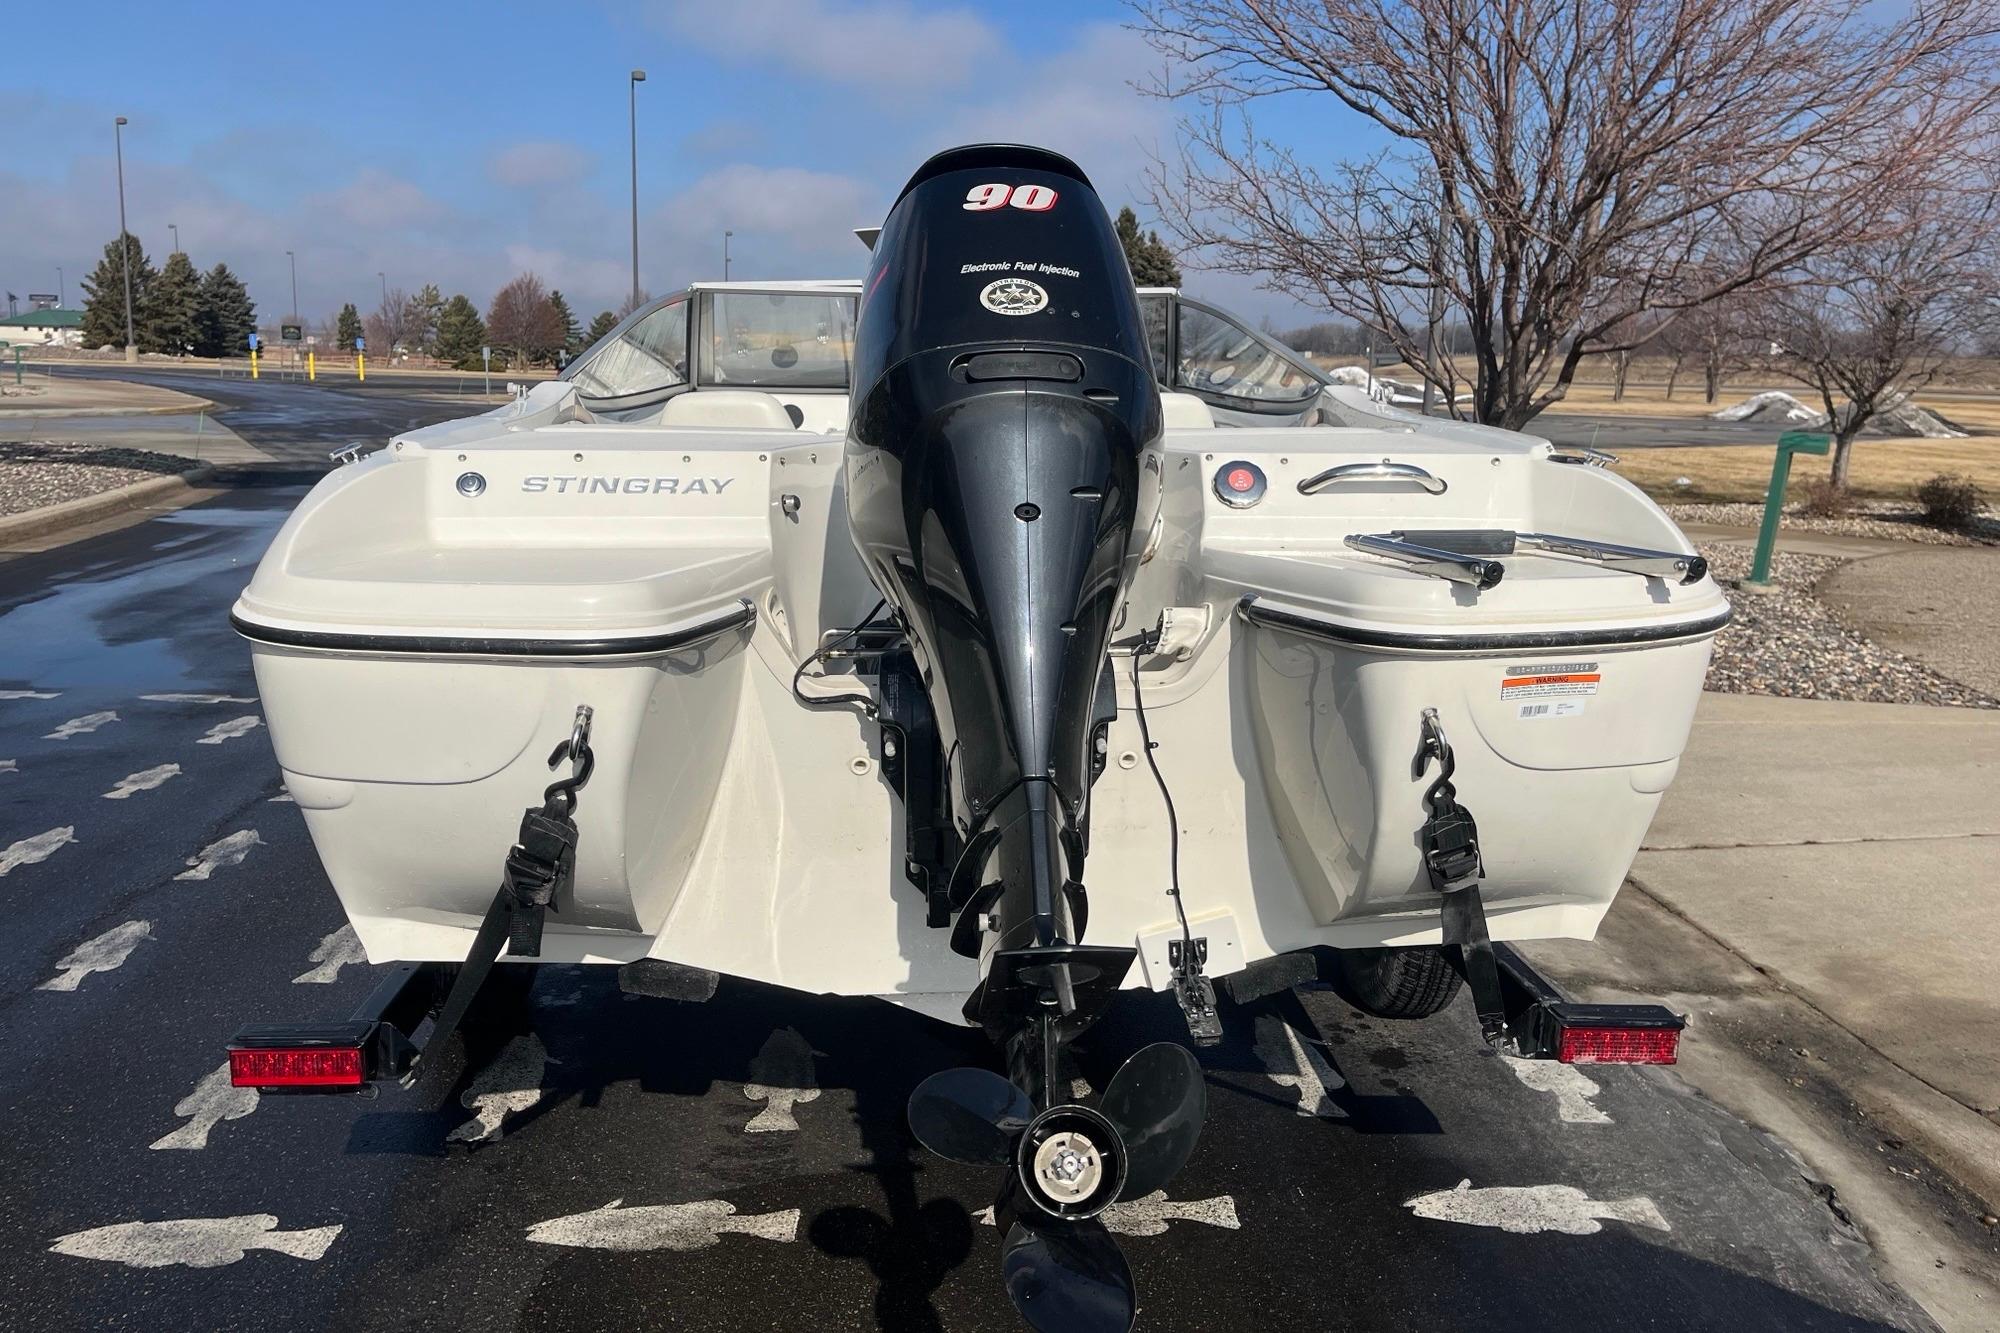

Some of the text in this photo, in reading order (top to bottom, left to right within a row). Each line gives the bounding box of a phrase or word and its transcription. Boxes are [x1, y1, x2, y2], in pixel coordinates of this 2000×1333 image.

[963, 184, 1058, 211] 90
[961, 261, 1080, 278] Electronic Fuel Injection
[521, 476, 736, 495] STINGRAY
[1536, 676, 1569, 684] WARNING
